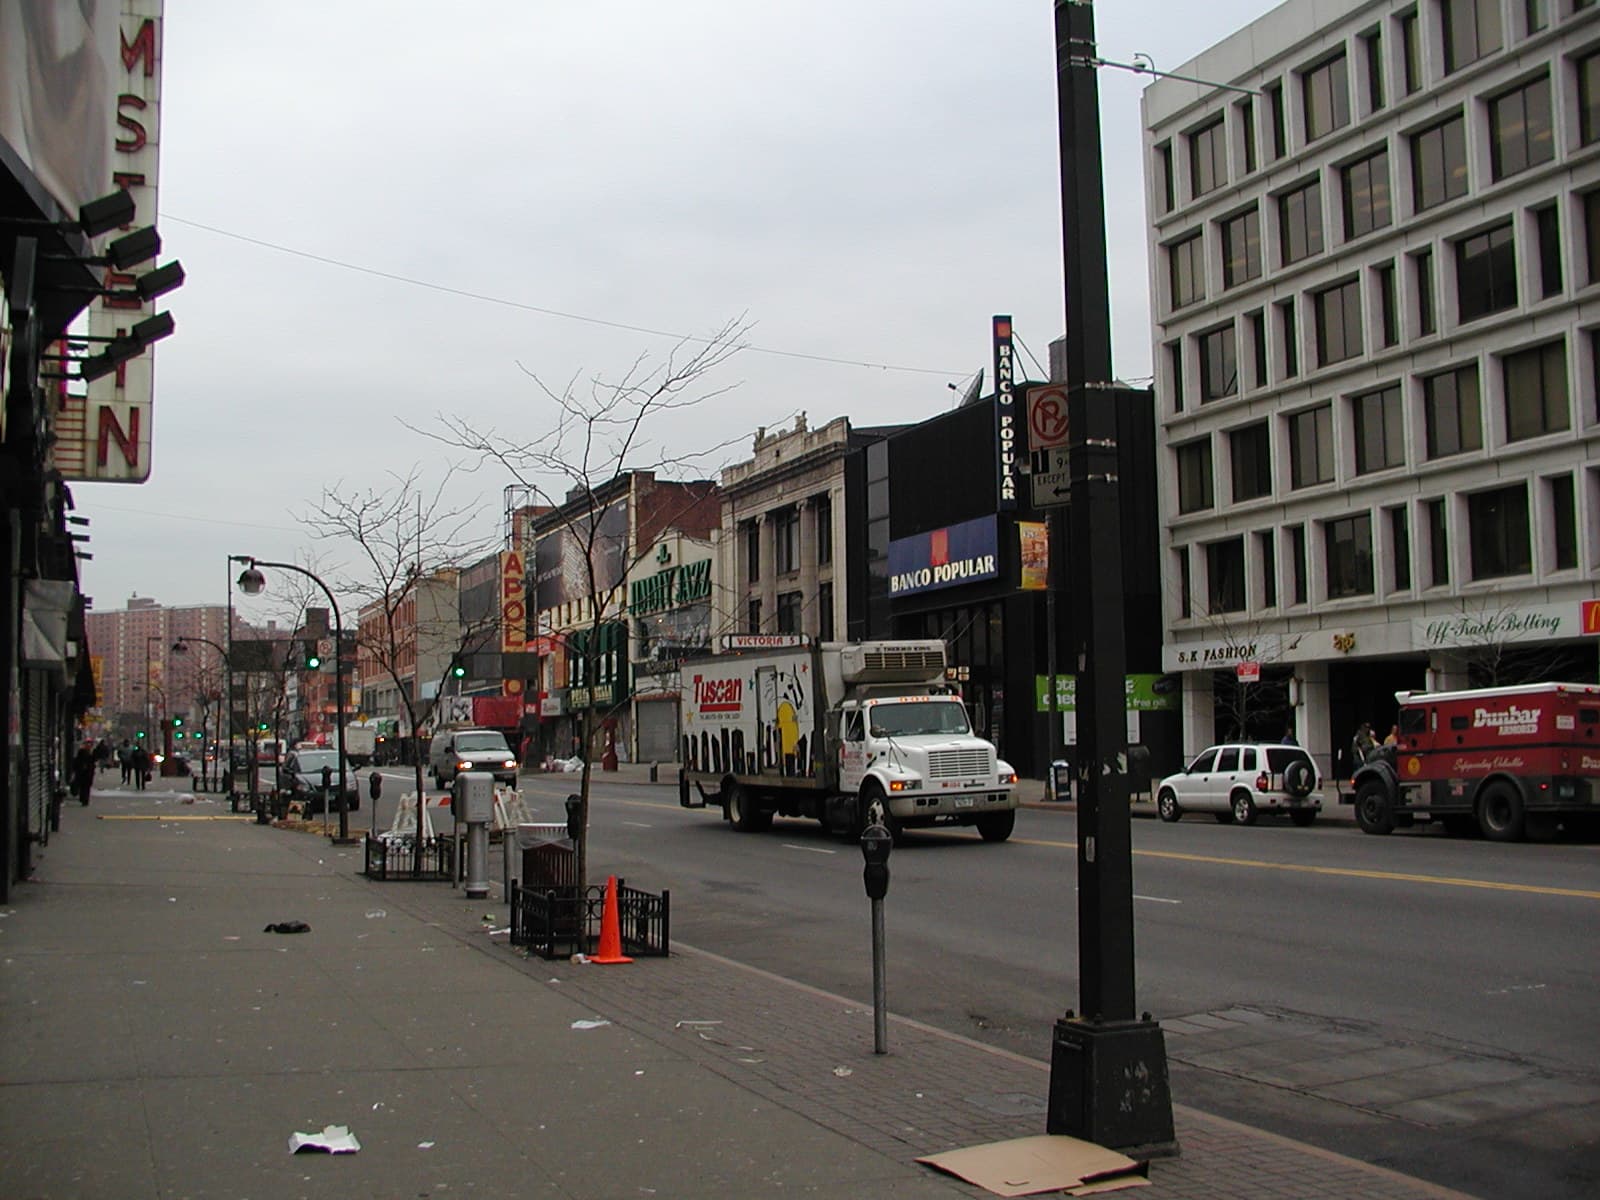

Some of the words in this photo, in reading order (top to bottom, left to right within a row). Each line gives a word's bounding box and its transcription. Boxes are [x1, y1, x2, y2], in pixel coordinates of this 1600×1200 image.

[998, 345, 1013, 405] BANCO
[1000, 416, 1016, 500] POPULAR
[629, 567, 677, 616] JIMMY
[675, 558, 712, 602] JAZZ
[891, 567, 931, 592] BANCO
[933, 554, 995, 584] POPULAR
[1499, 612, 1561, 637] Betting
[737, 636, 784, 645] VICTORIA
[1203, 644, 1258, 663] FASHION
[693, 674, 743, 704] Tuscan
[1473, 705, 1542, 728] Dunbar
